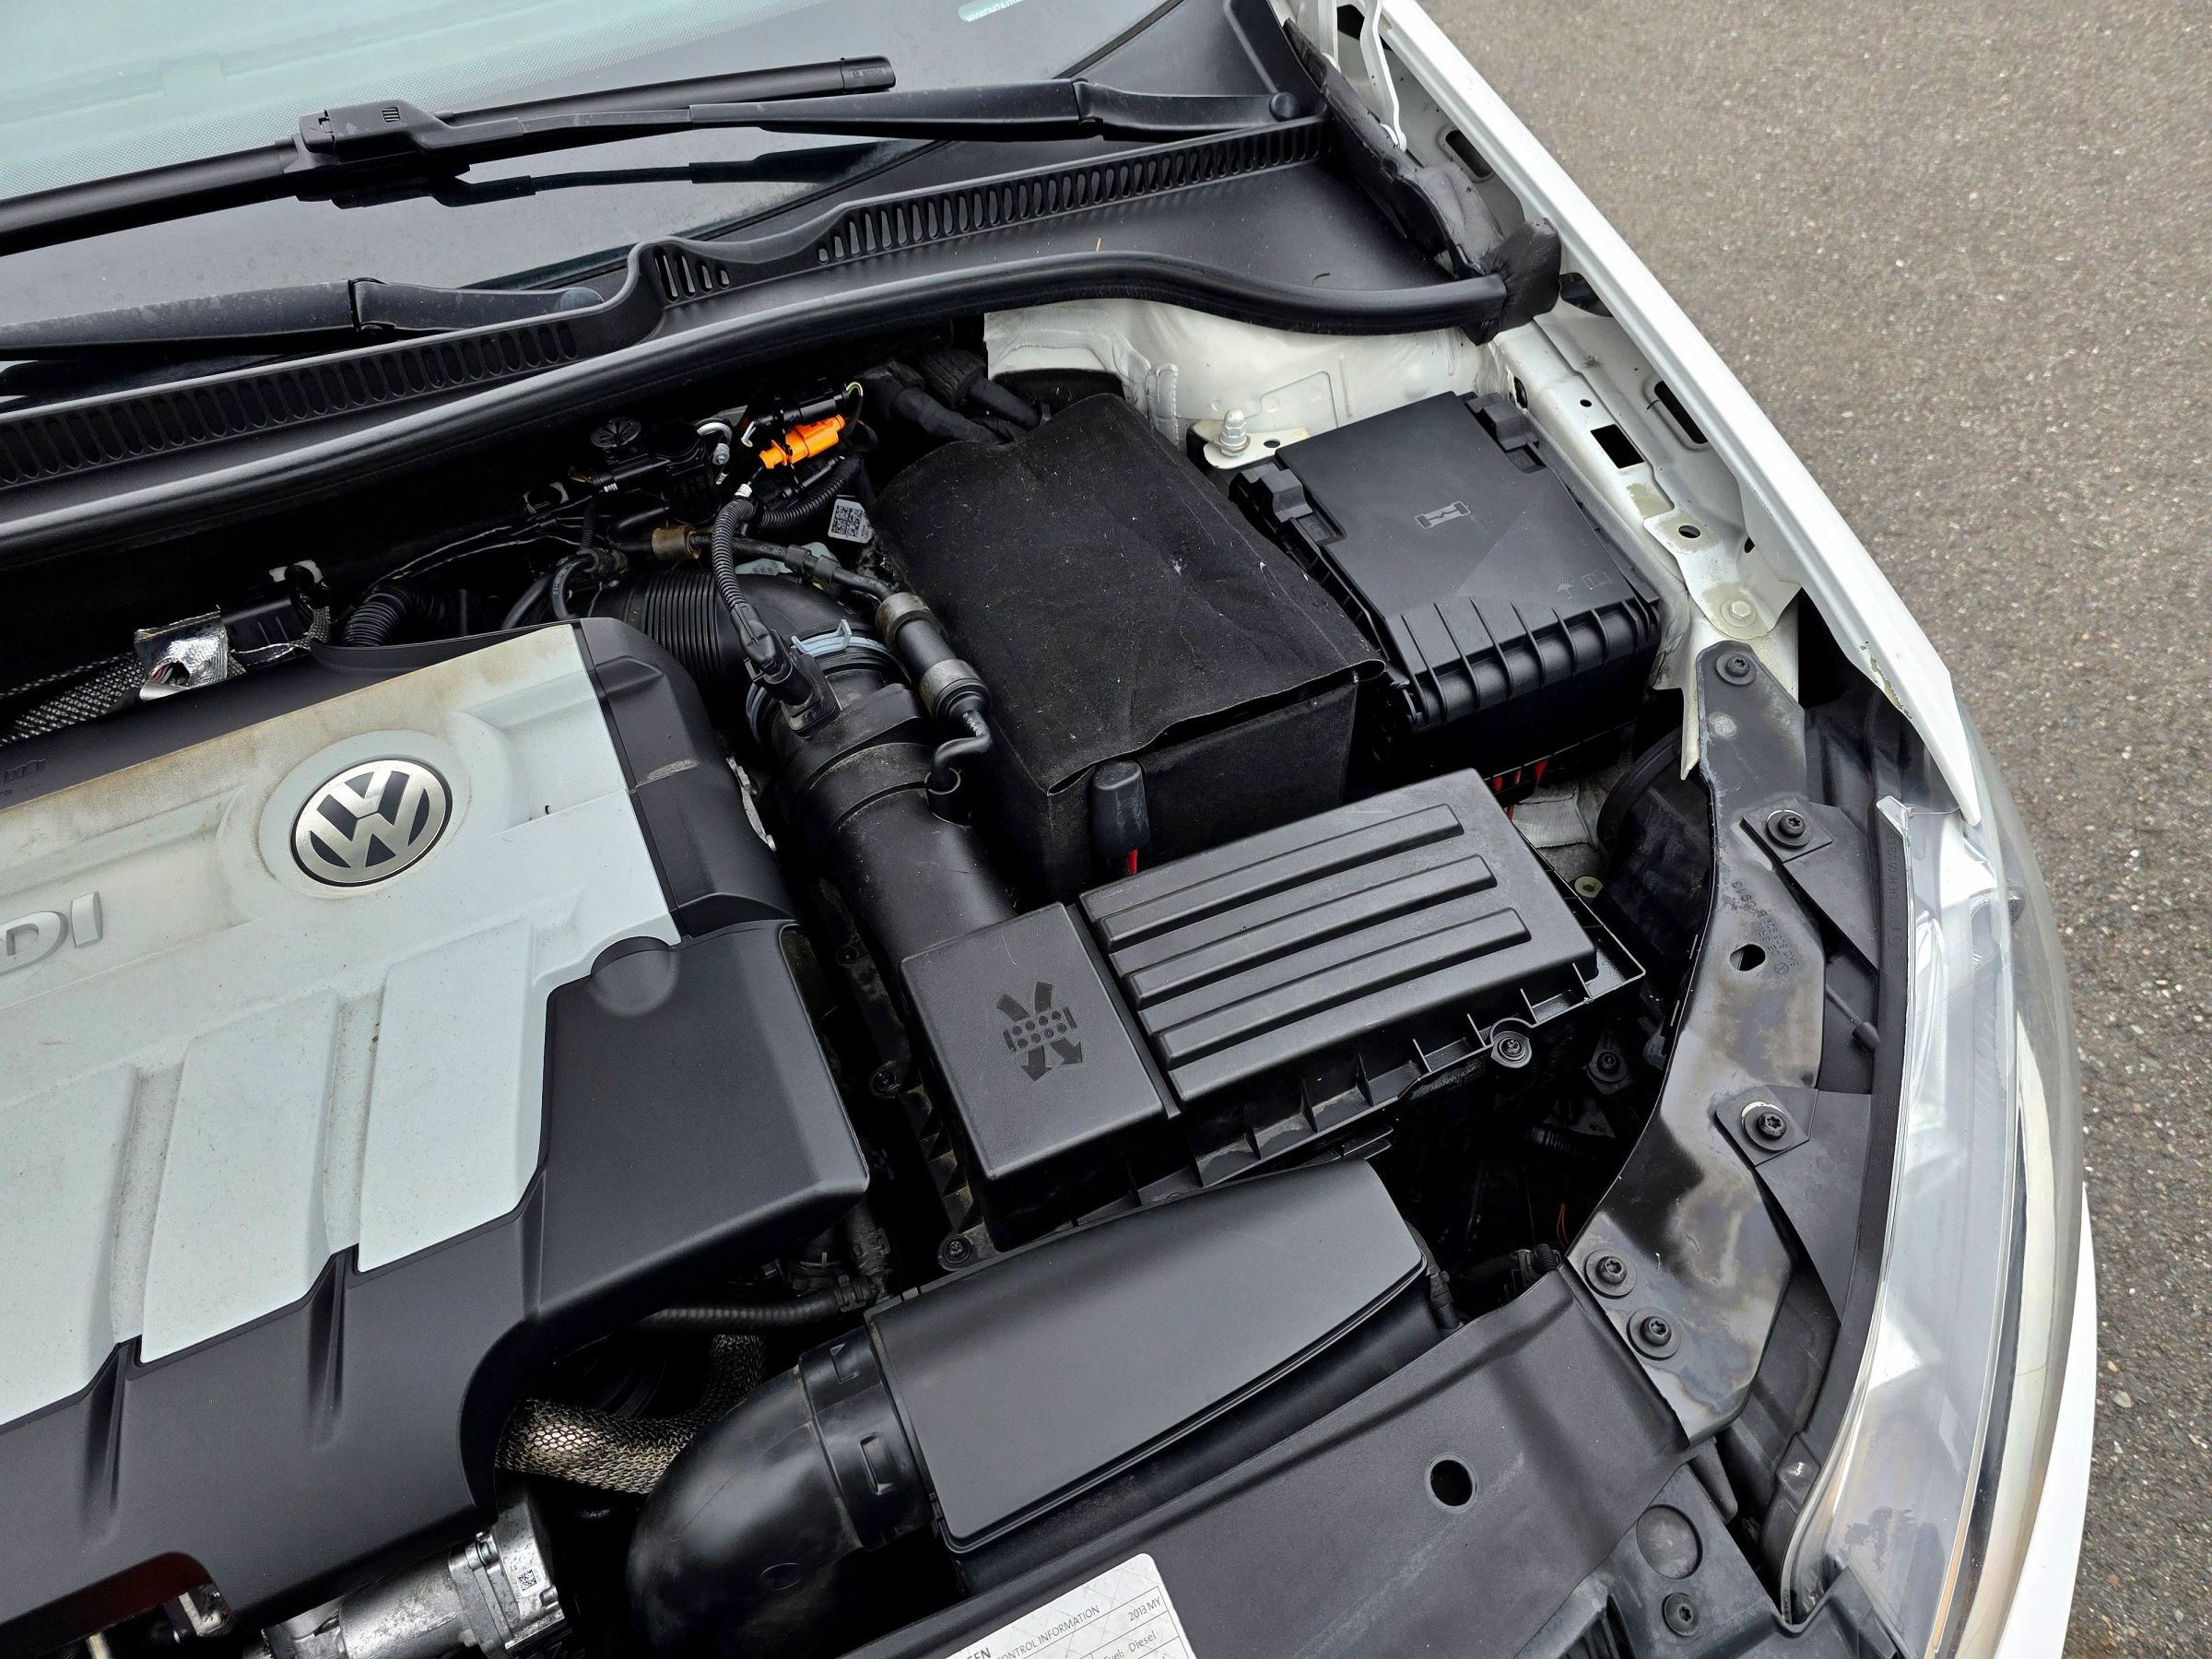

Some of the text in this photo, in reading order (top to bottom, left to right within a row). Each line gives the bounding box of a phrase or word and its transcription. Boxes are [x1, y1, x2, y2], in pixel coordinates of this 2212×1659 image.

[1128, 1596, 1161, 1621] 2013 MY
[1038, 1605, 1100, 1644] INFORMATION
[1128, 1630, 1157, 1653] Diesel
